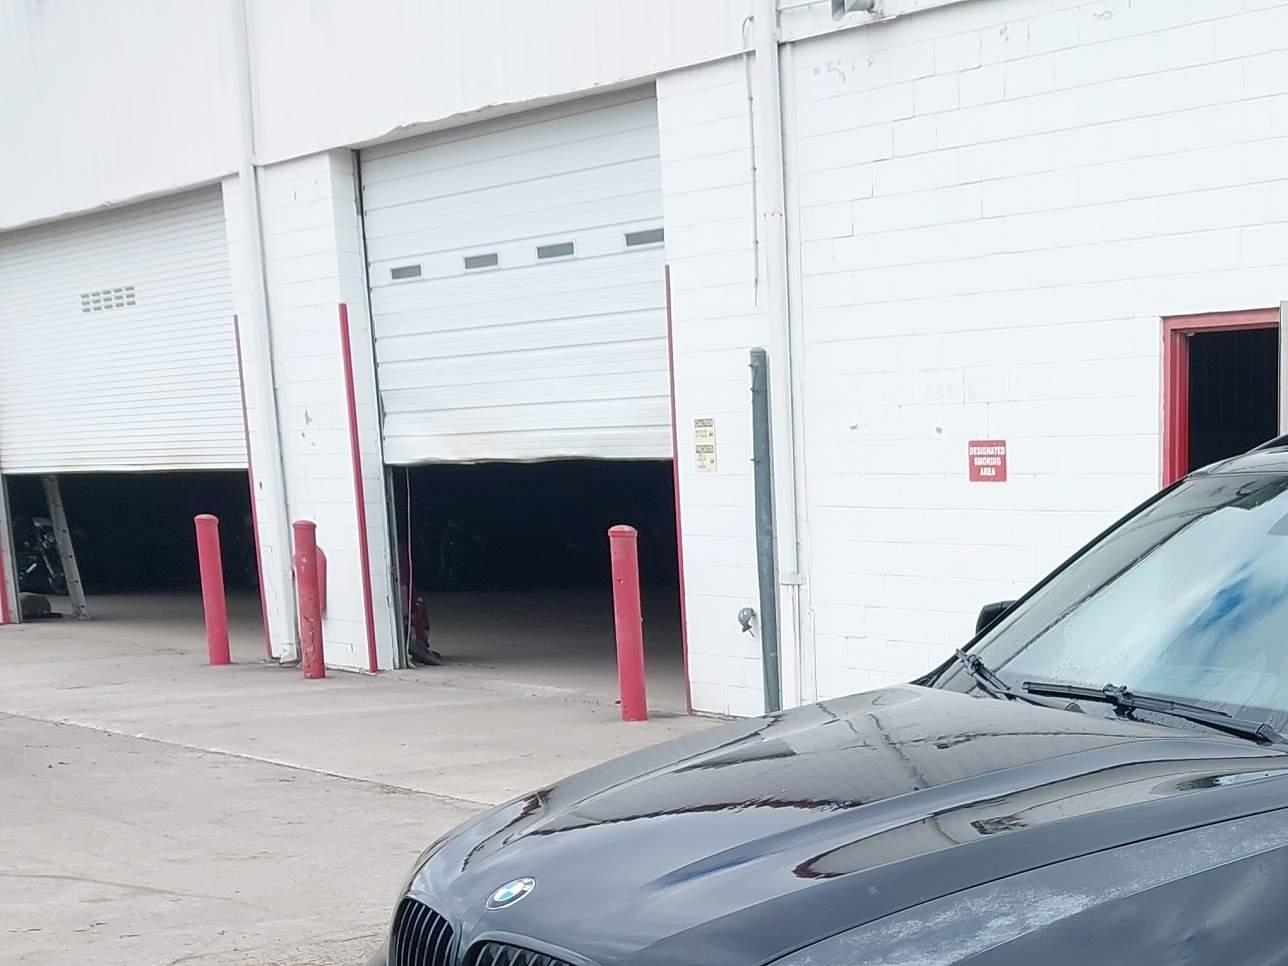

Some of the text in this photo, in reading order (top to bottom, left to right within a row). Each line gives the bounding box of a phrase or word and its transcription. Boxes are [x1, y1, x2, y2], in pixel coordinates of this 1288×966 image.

[969, 446, 1006, 456] DESIGNATED
[974, 456, 1002, 466] SMOKING
[979, 466, 996, 476] AREA
